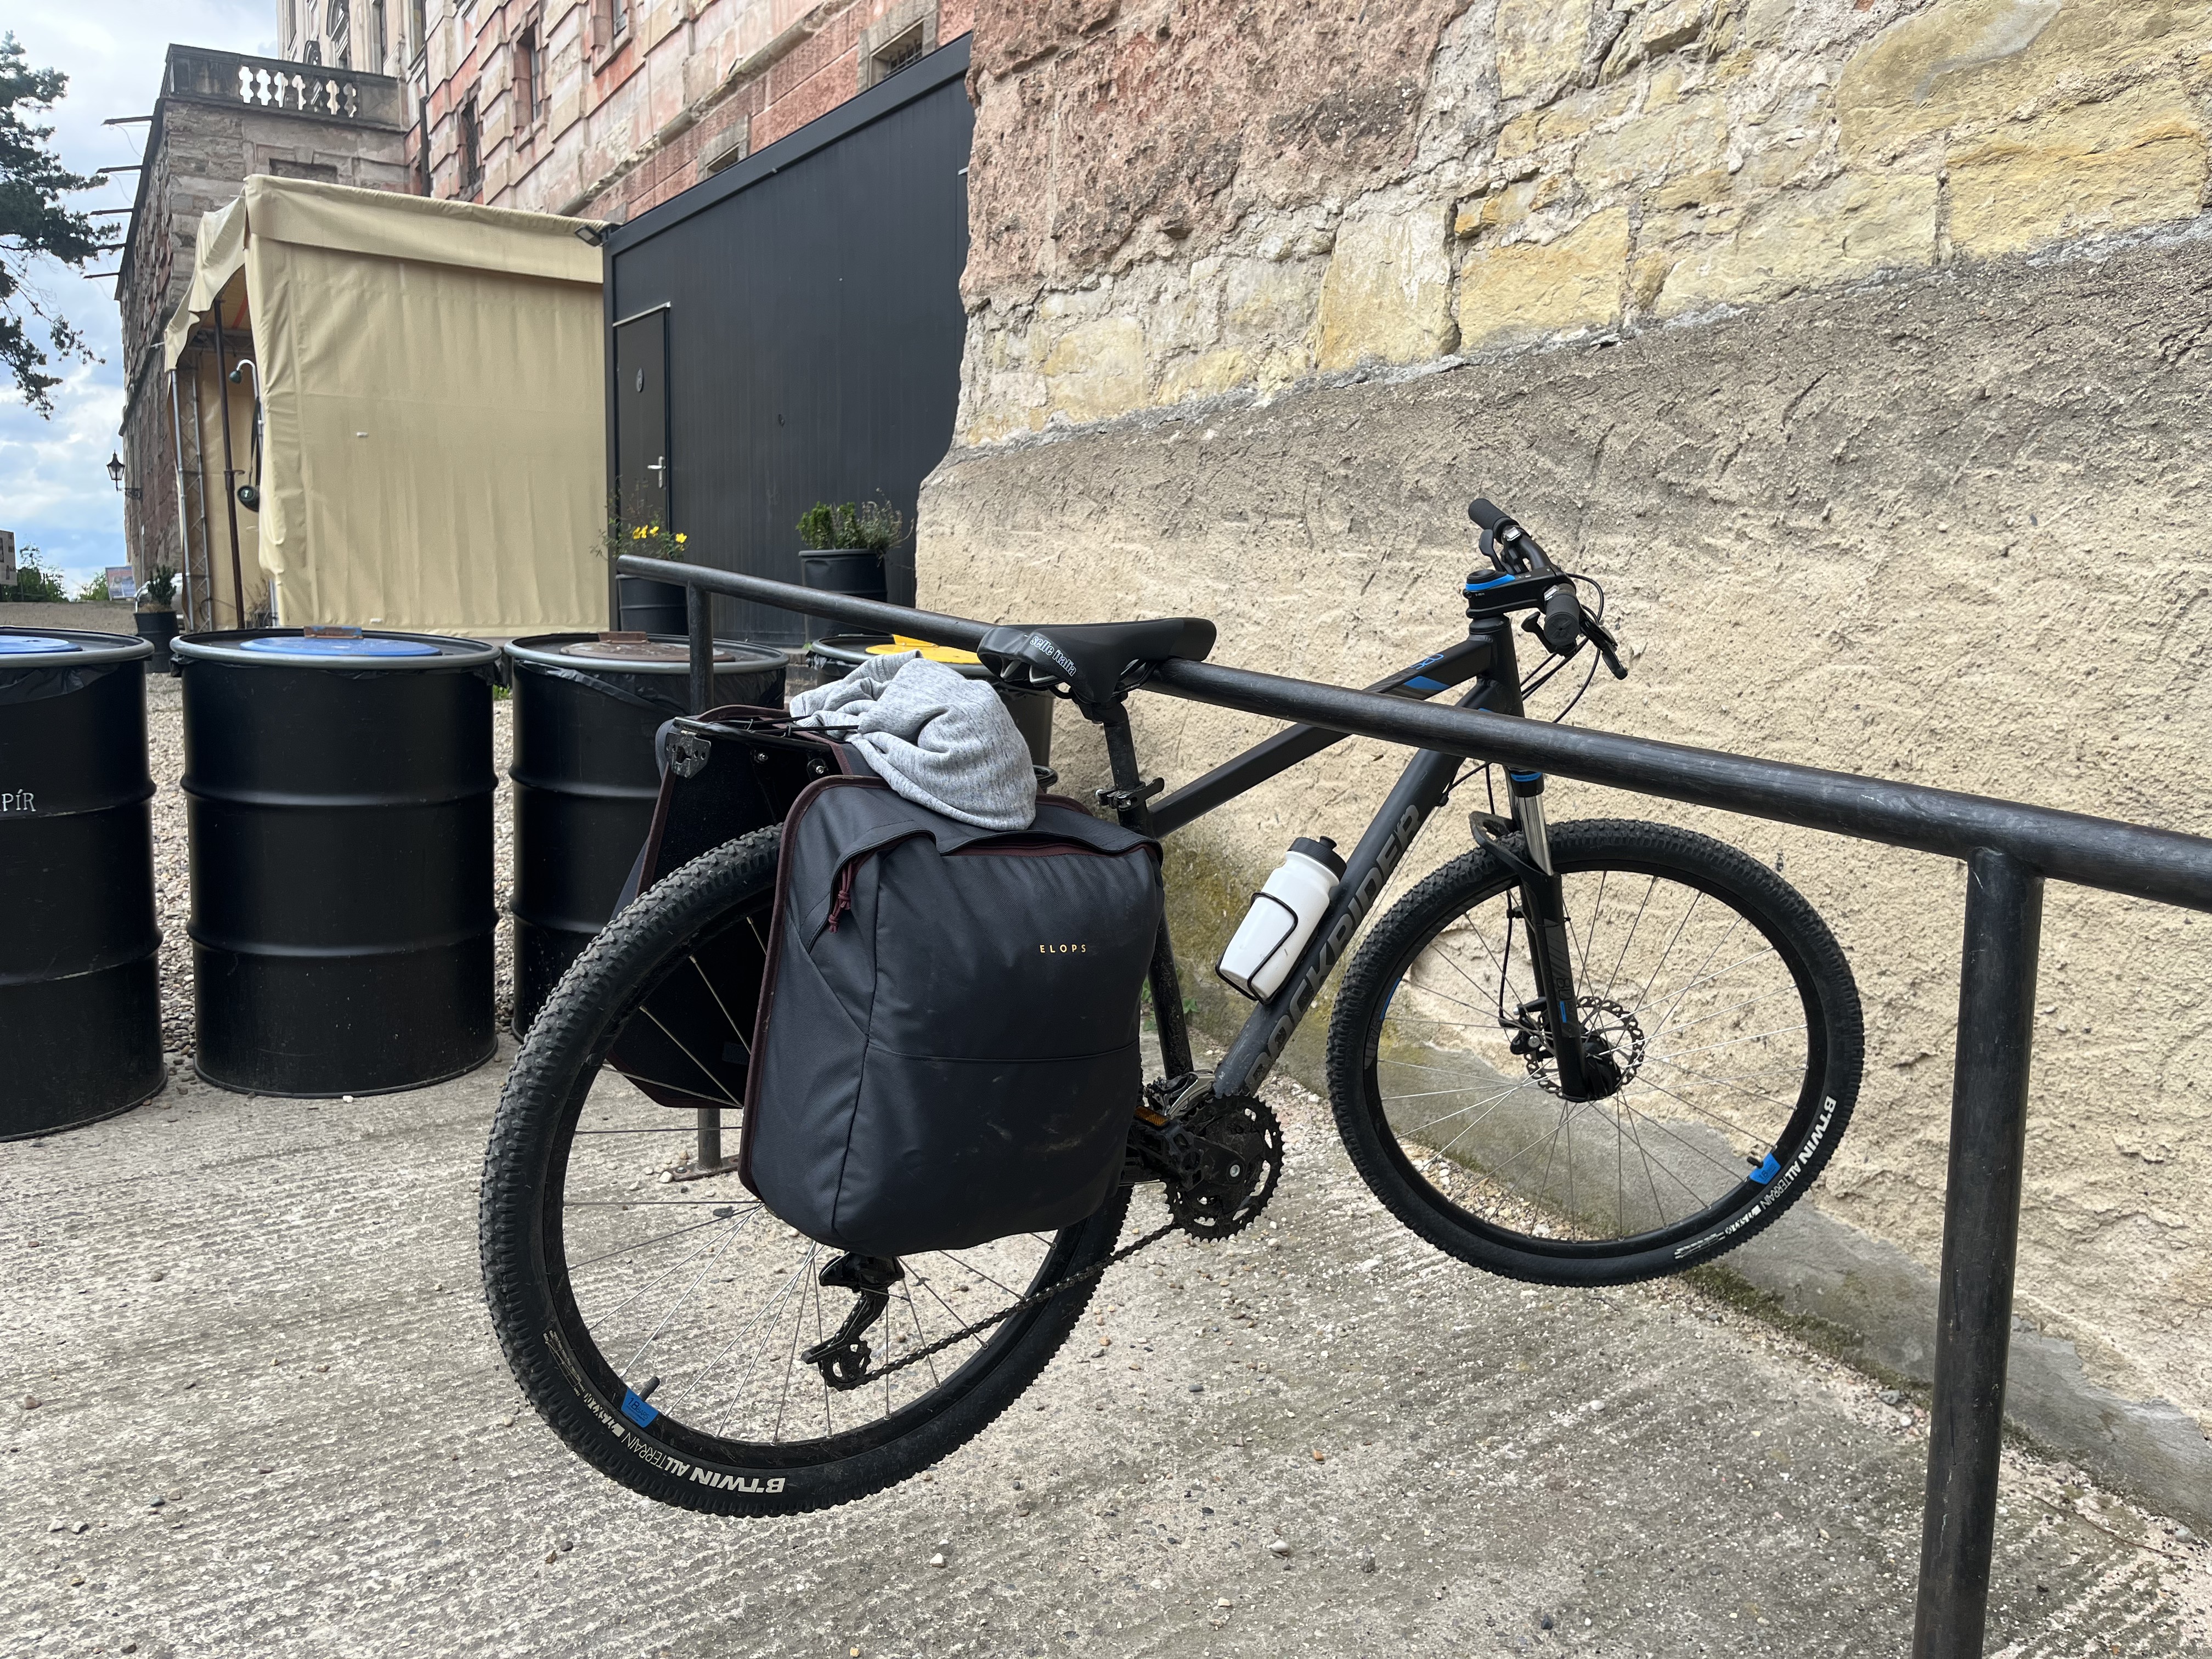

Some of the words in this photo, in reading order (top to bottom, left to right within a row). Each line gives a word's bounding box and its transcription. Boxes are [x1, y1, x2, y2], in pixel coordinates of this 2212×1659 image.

[1030, 636, 1055, 656] selle
[1052, 649, 1077, 677] italia
[0, 788, 37, 812] PÍR
[1039, 944, 1087, 953] ELOPS
[1244, 804, 1420, 1096] ROCKRIDER
